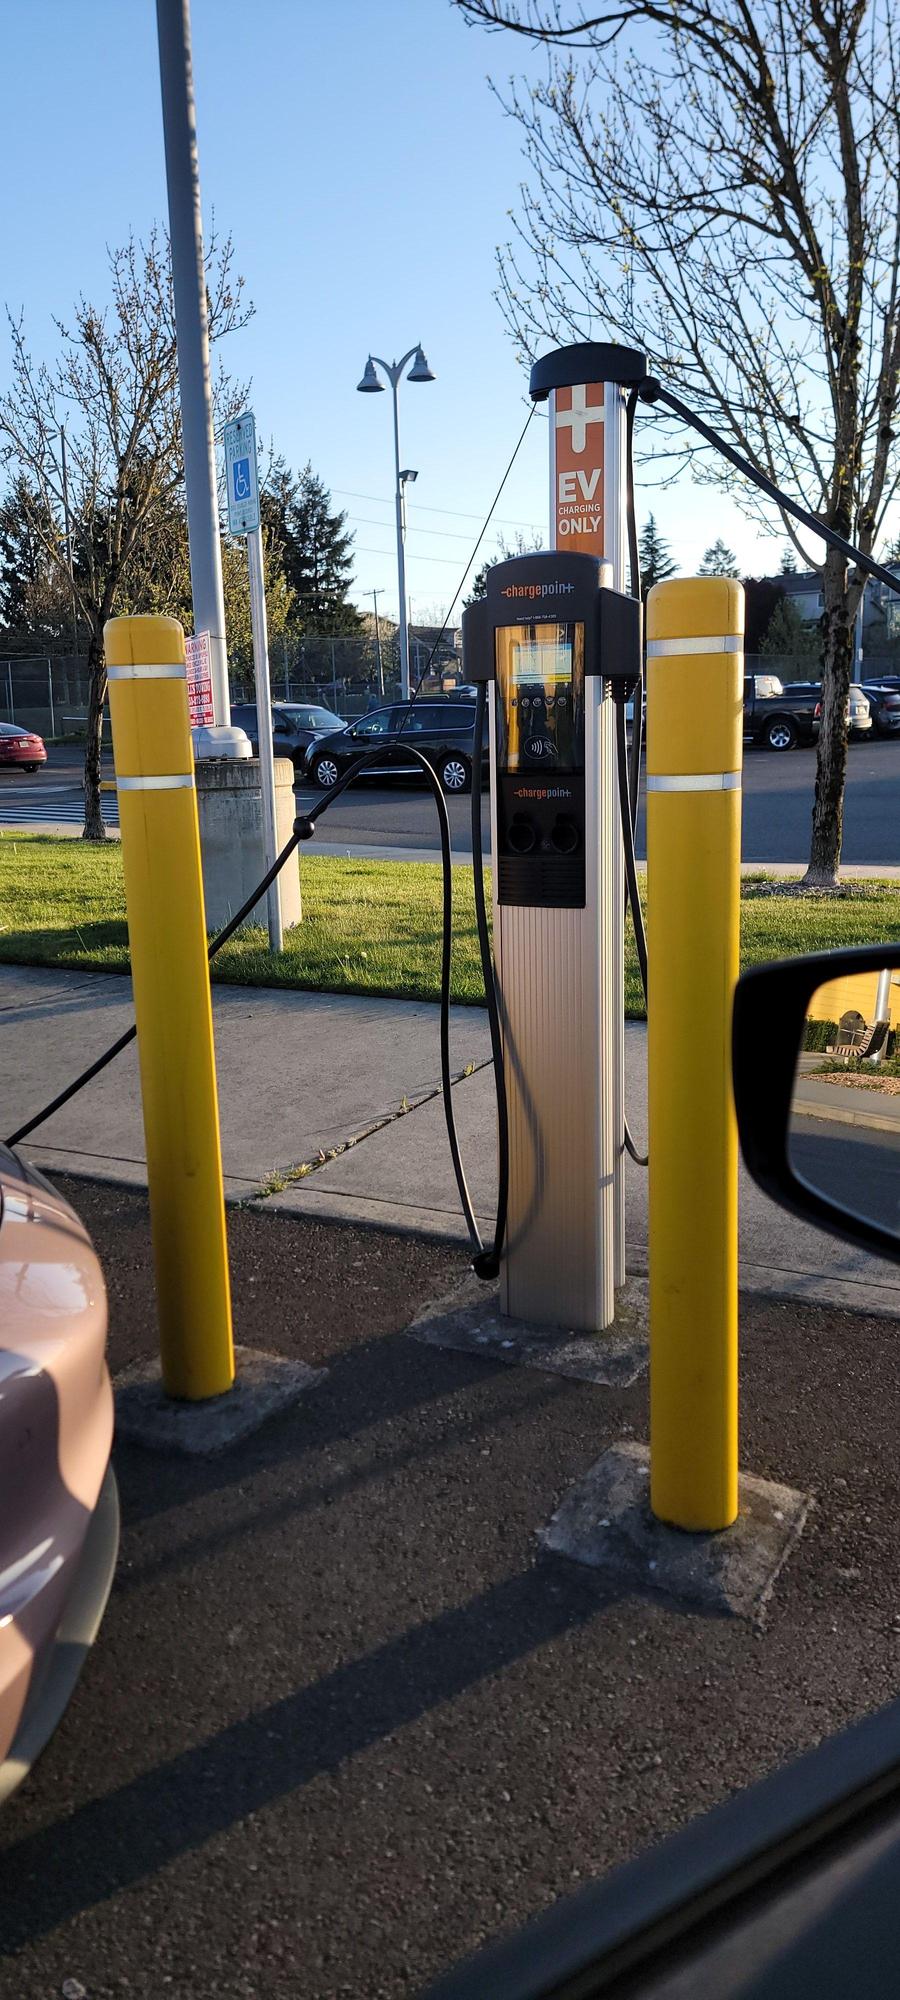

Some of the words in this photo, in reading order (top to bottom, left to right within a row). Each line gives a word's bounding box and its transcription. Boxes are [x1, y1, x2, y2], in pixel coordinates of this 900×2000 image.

[226, 423, 252, 445] RESERVED
[229, 440, 251, 461] PARKING
[558, 468, 601, 503] EV
[558, 504, 600, 514] CHARGING
[558, 516, 602, 536] ONLY
